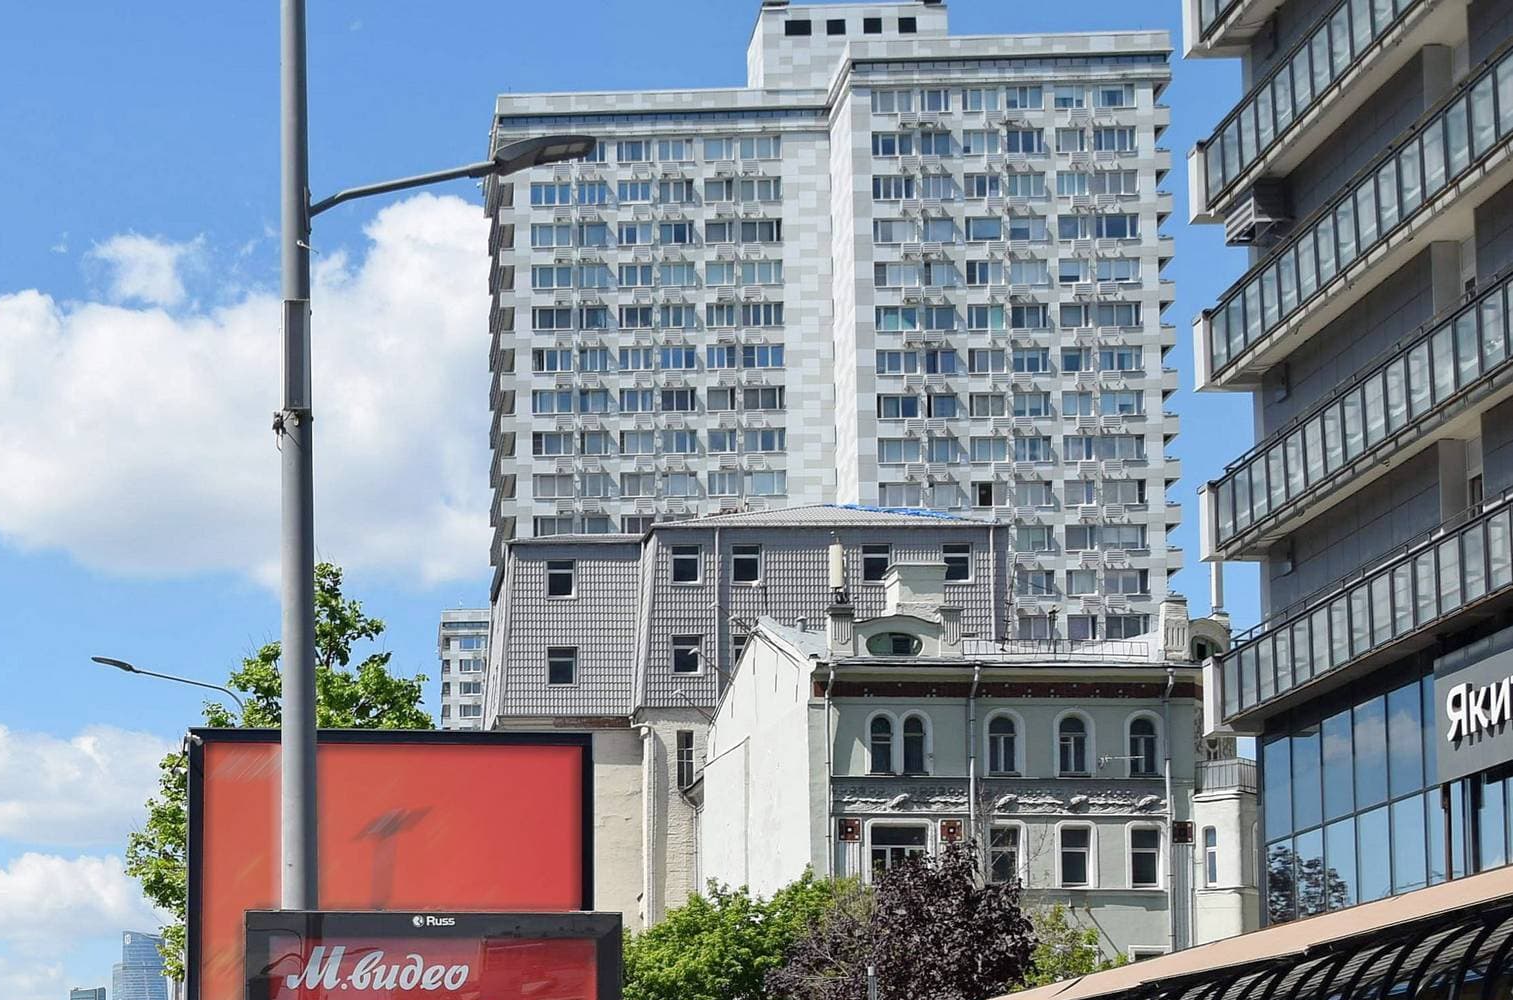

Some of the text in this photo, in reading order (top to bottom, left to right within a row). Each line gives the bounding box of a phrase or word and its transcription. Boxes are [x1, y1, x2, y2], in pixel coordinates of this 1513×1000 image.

[1447, 675, 1513, 742] Яки
[426, 915, 456, 926] Russ
[286, 945, 470, 992] М.видео
